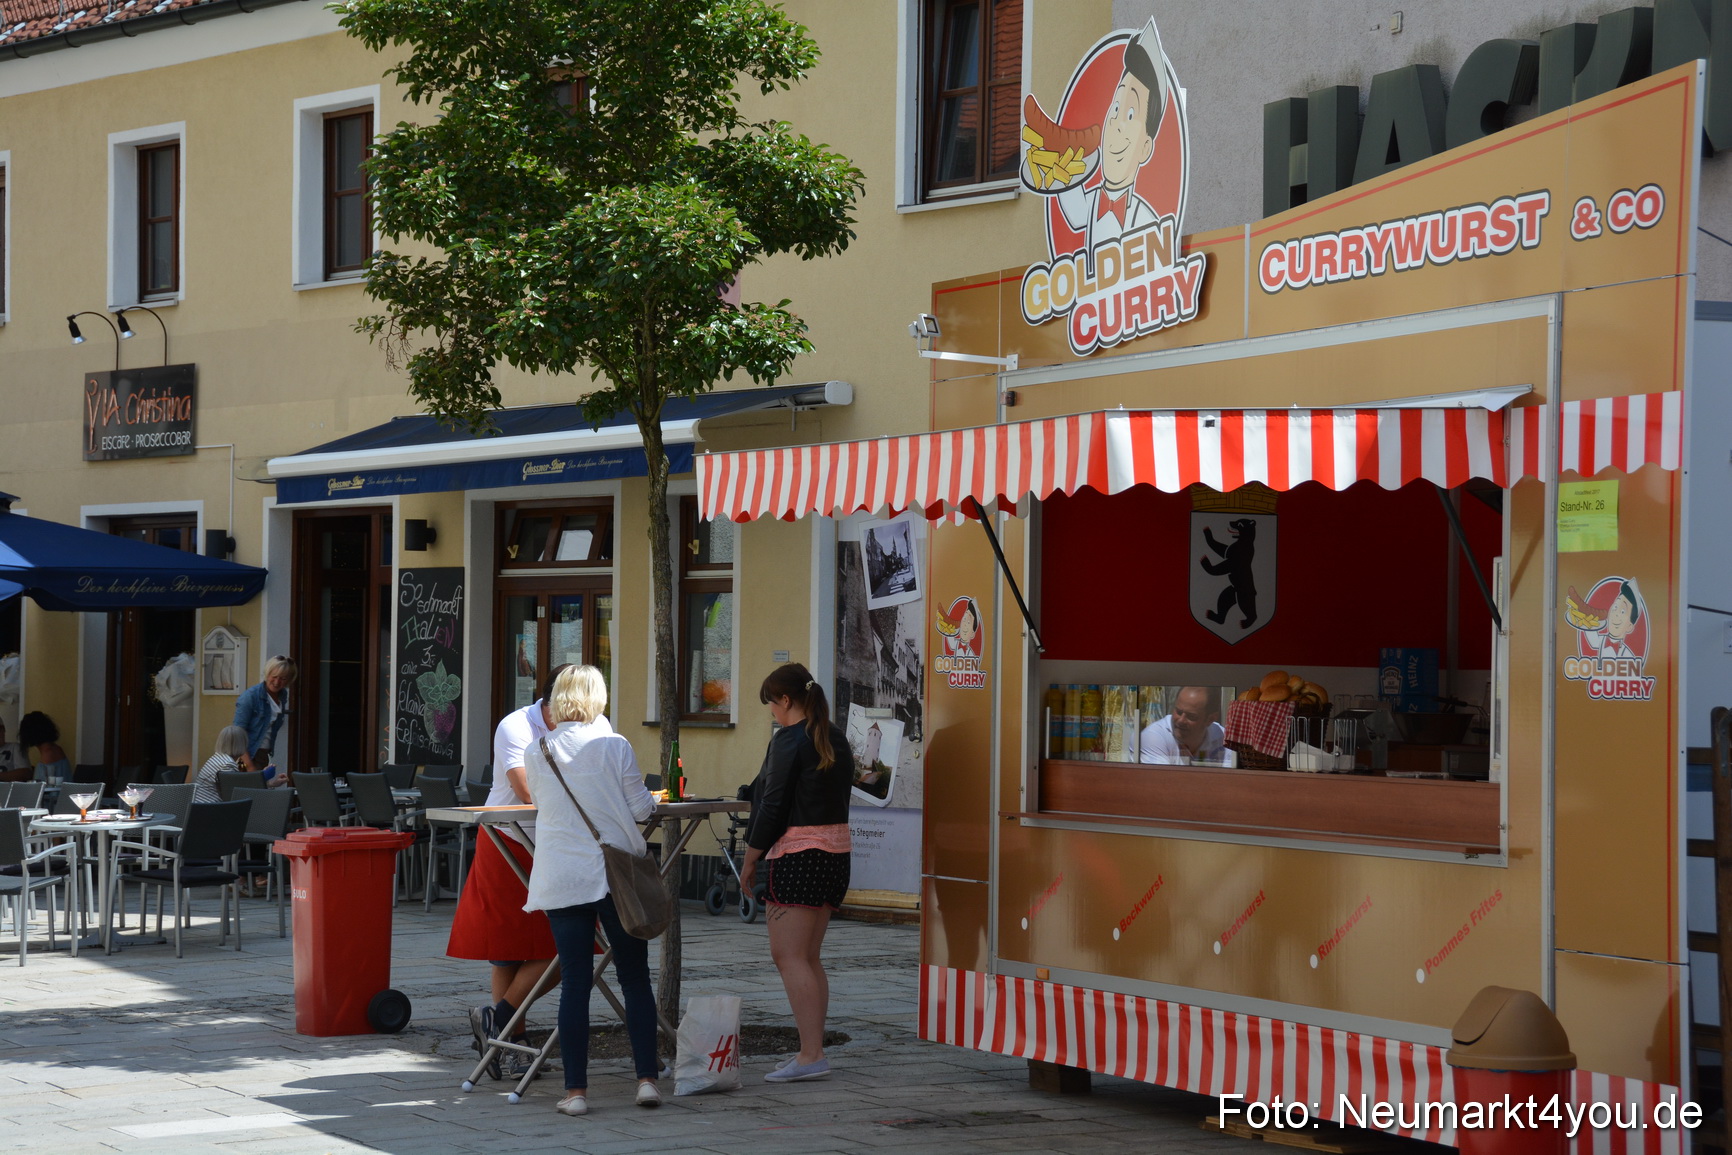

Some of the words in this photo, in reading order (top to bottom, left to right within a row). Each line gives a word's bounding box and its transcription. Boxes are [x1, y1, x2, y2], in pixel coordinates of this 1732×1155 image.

[1260, 197, 1547, 290] CURRYWURST
[1572, 202, 1599, 236] &
[1609, 189, 1664, 228] CO
[1024, 224, 1173, 317] GOLDEN
[1072, 264, 1200, 346] CURRY
[126, 387, 192, 425] Christina
[1560, 501, 1594, 512] Stand-Nr.
[1595, 499, 1605, 511] 26
[74, 575, 104, 594] Der
[107, 577, 167, 599] hochfeine
[170, 575, 244, 598] Biergenuss
[400, 571, 423, 607] So
[935, 657, 979, 673] GOLDEN
[949, 672, 986, 687] CURRY
[1408, 655, 1419, 689] HEINZ
[1564, 659, 1642, 678] GOLDEN
[1588, 678, 1654, 697] CURRY
[856, 828, 886, 839] Stegmeier
[1119, 873, 1165, 934] Bockwurst
[1220, 889, 1266, 947] Bratwurst
[1316, 894, 1374, 961] Rindswurst
[1424, 923, 1471, 976] Pommes
[1469, 888, 1504, 928] Frites
